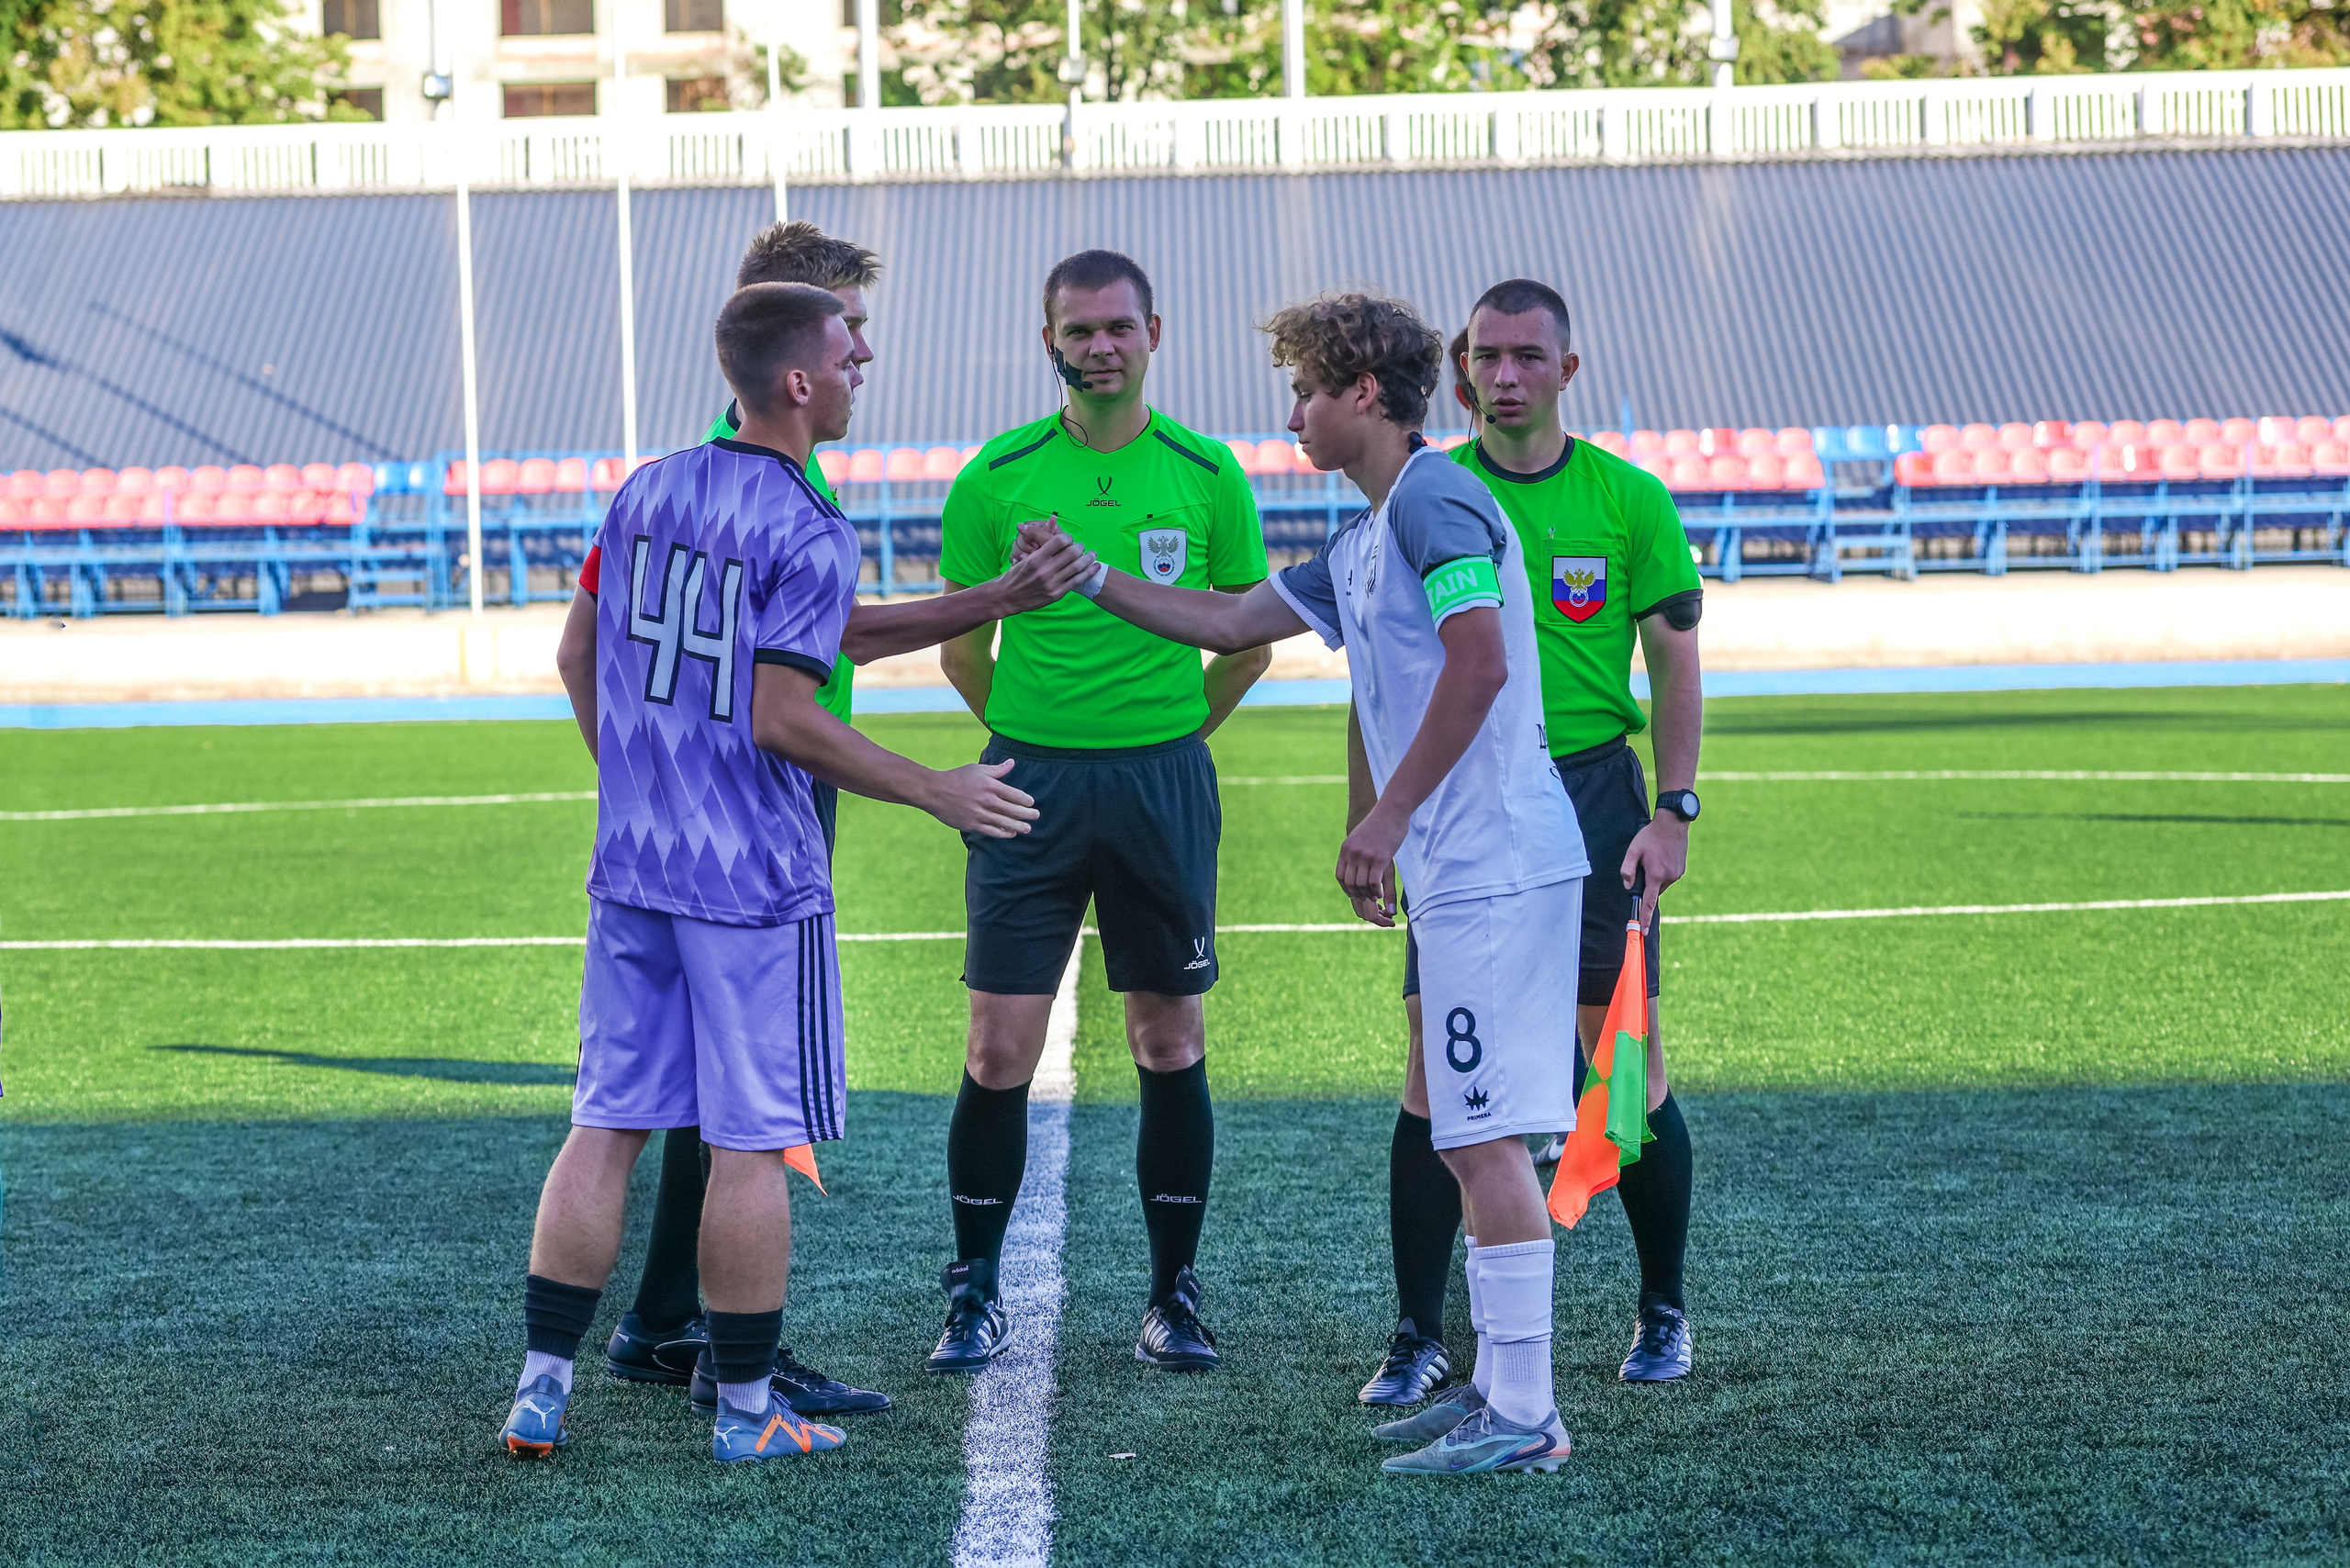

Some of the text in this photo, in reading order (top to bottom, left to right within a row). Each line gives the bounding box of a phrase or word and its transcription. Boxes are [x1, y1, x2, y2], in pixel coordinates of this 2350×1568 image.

[1085, 498, 1122, 507] JÖGEL
[627, 534, 744, 723] 44
[1183, 958, 1211, 969] JÖGEL
[1446, 1006, 1483, 1073] 8
[1467, 1112, 1492, 1121] PRIMERA
[952, 1194, 1003, 1205] JÖGEL
[1149, 1193, 1203, 1204] JÖGEL
